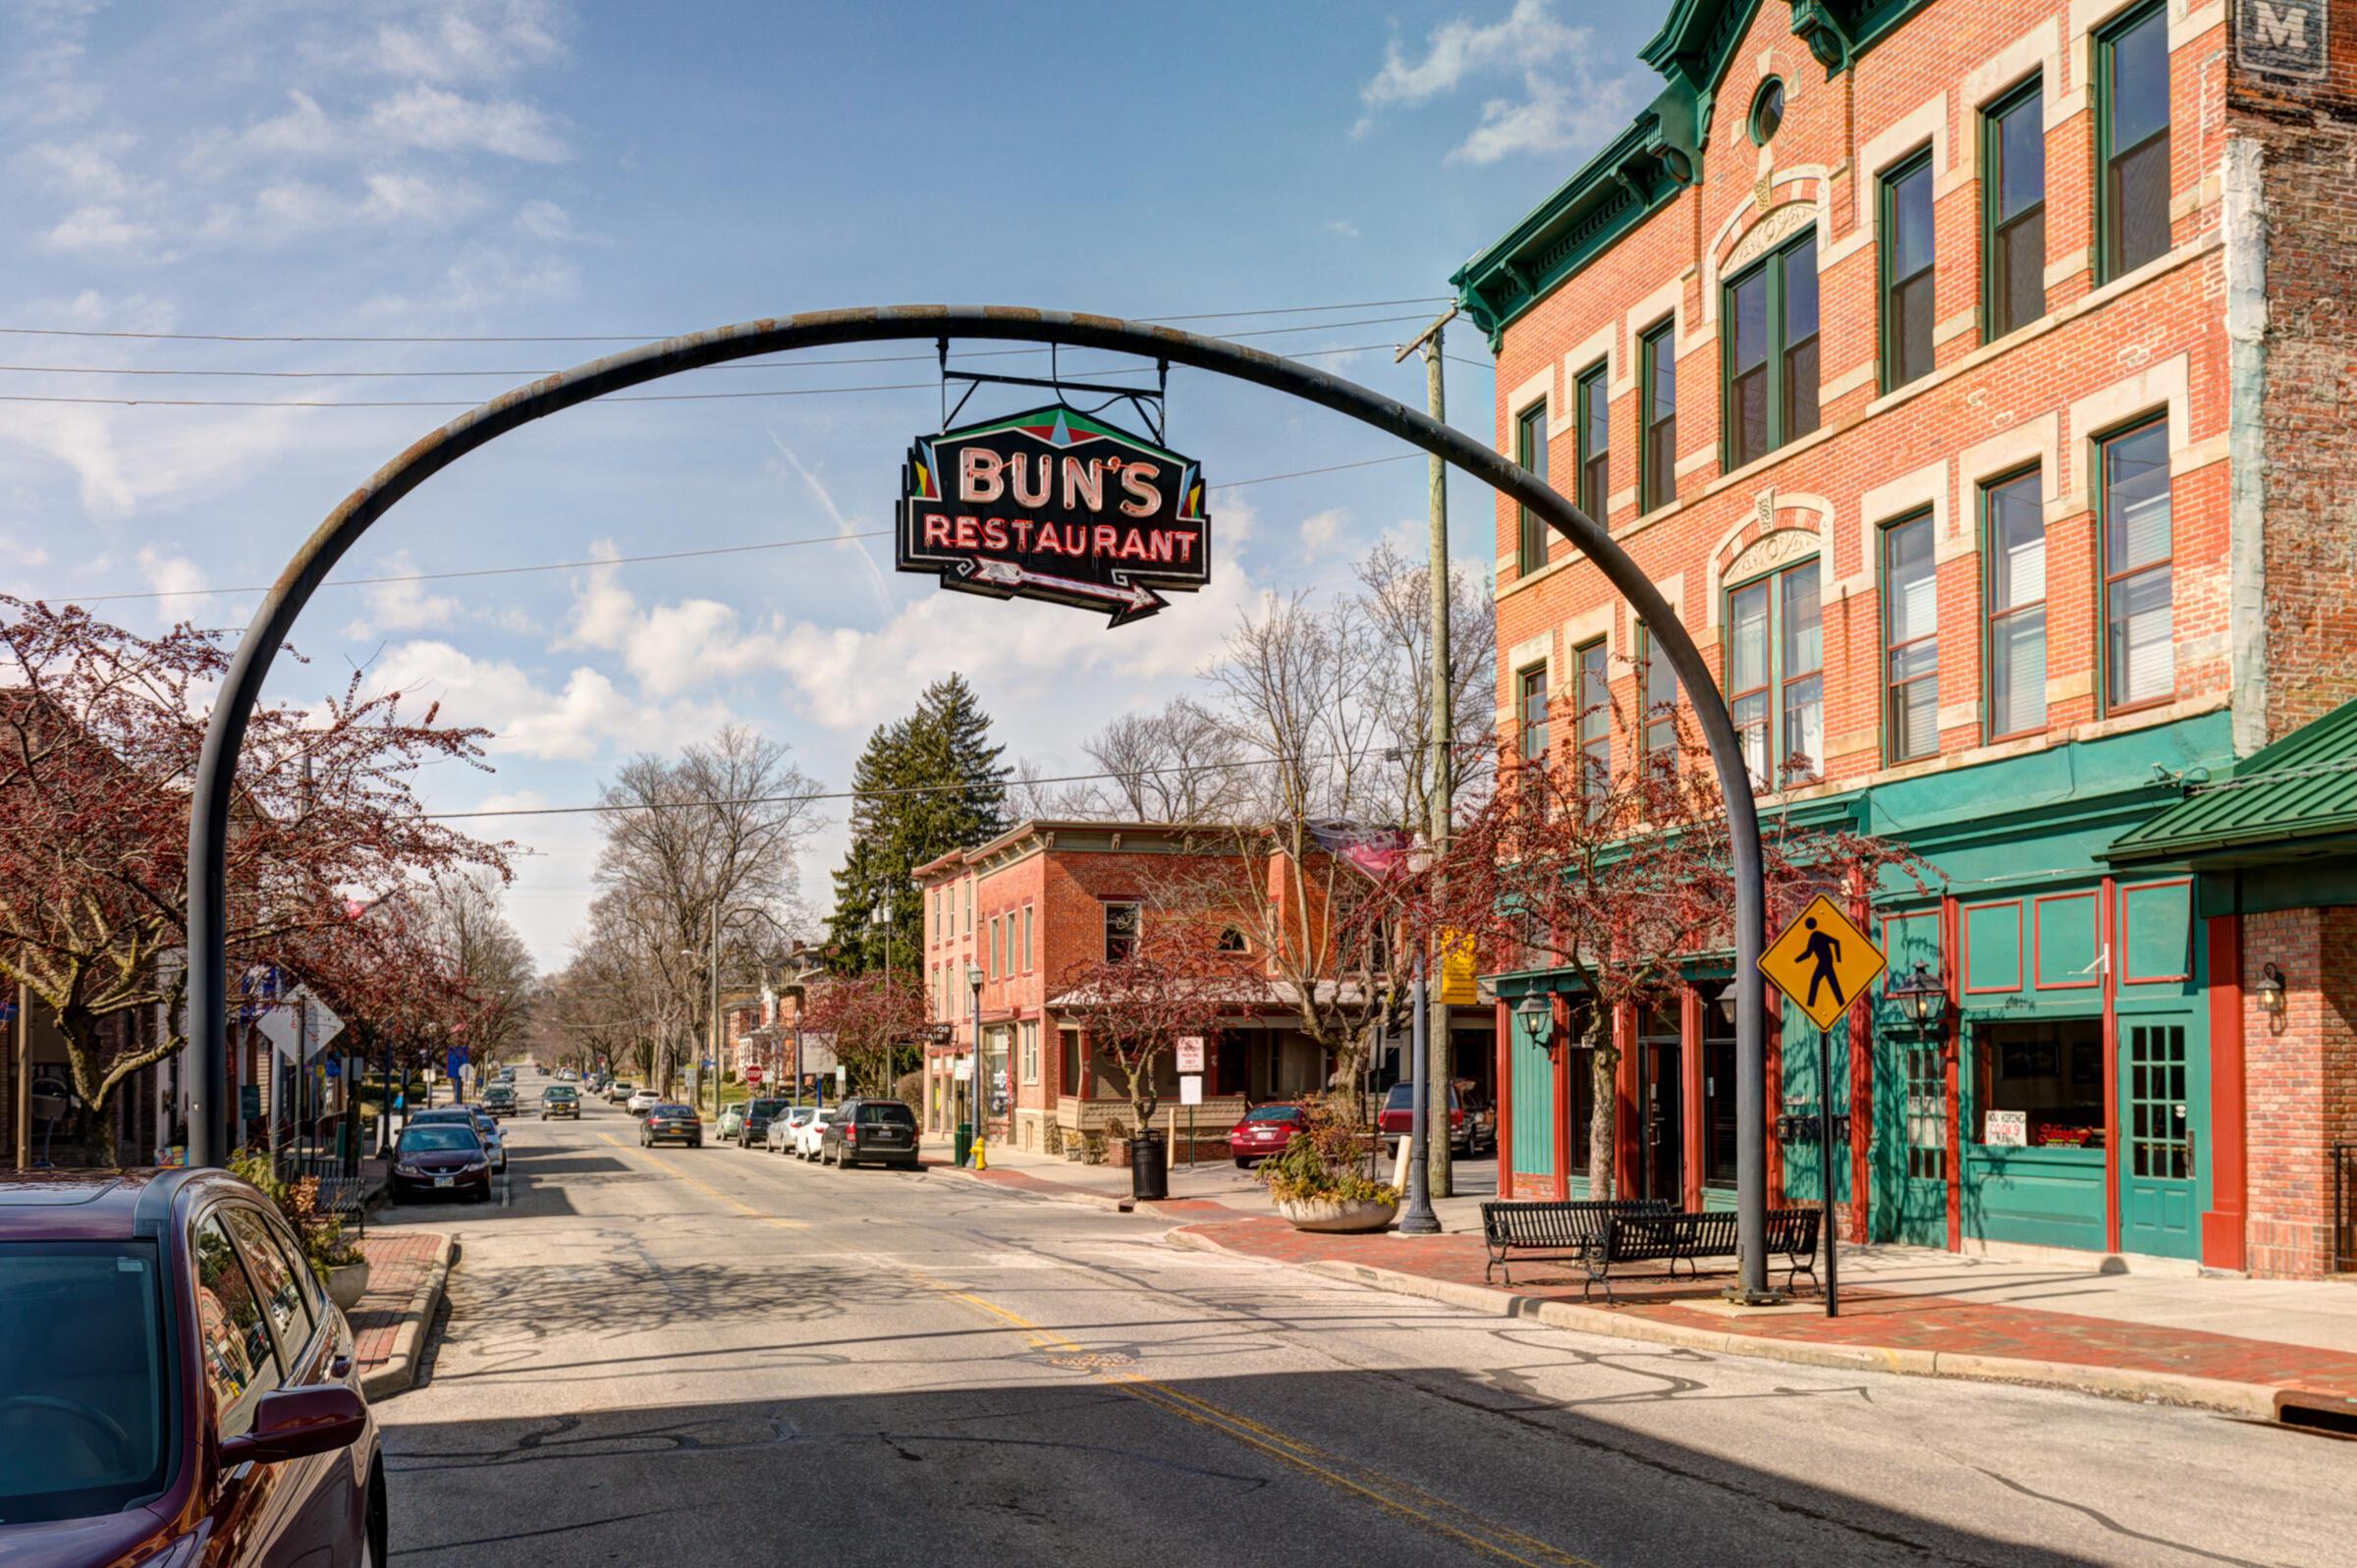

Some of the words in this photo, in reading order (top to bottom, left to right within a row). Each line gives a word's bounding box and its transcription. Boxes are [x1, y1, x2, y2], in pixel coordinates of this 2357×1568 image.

[2254, 1, 2307, 48] M
[959, 447, 1163, 518] BUN'S
[923, 514, 1198, 563] RESTAURANT
